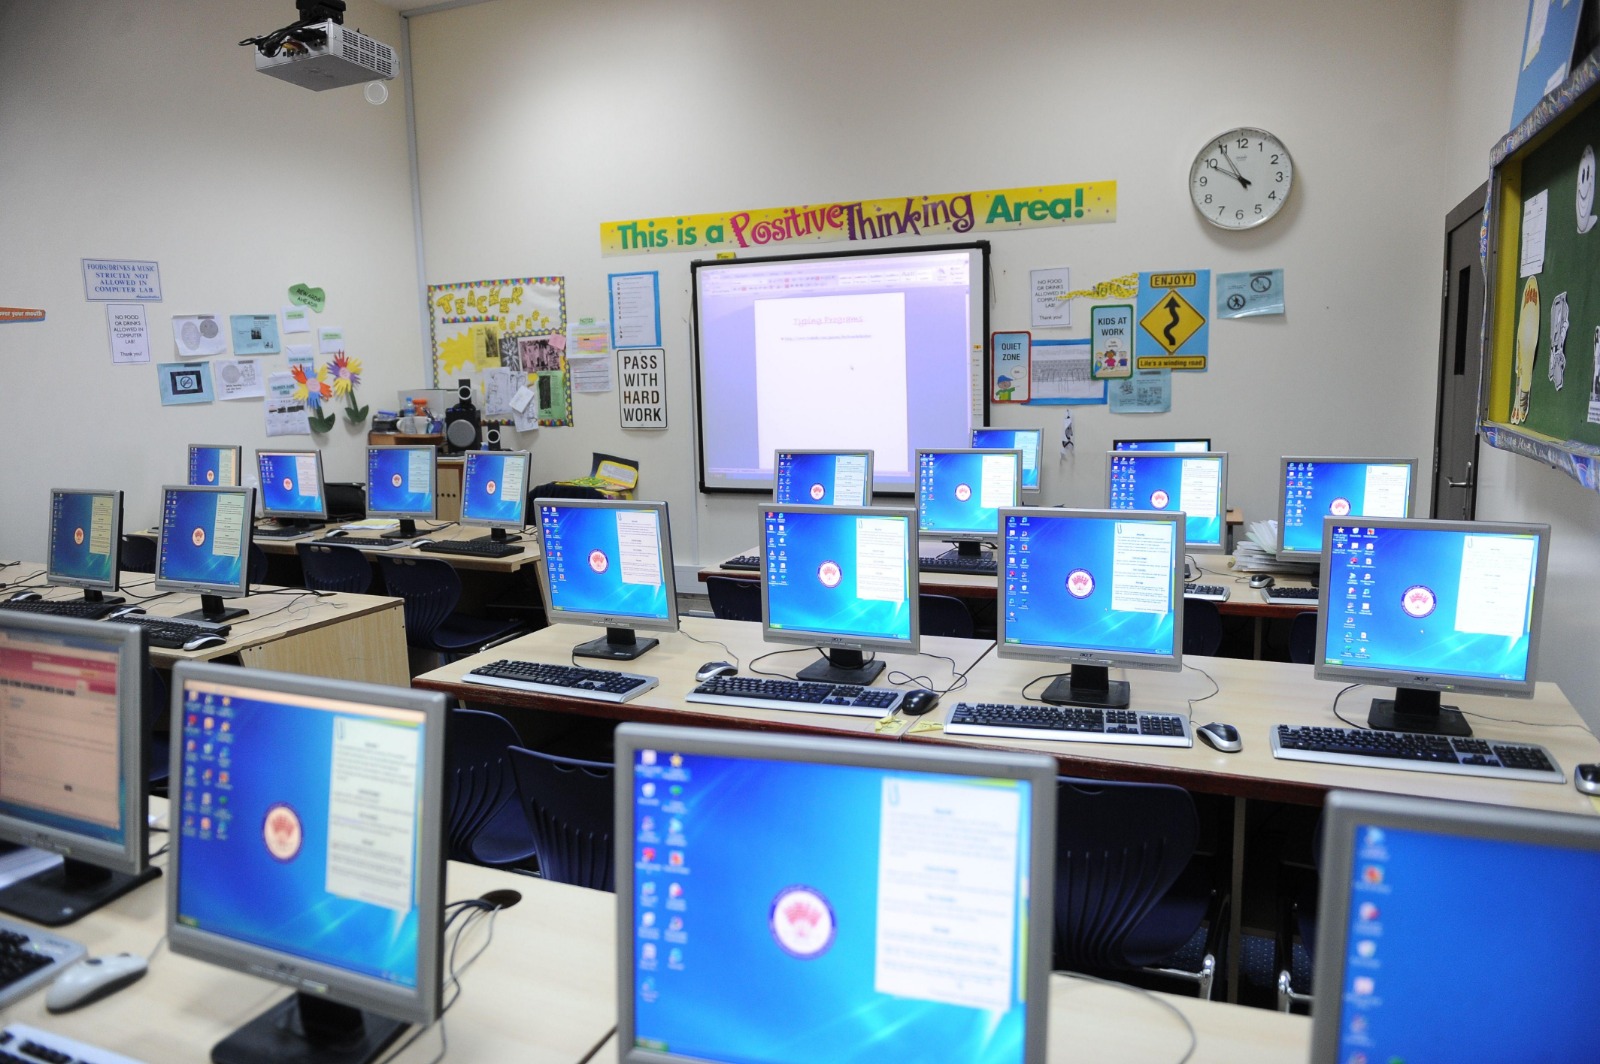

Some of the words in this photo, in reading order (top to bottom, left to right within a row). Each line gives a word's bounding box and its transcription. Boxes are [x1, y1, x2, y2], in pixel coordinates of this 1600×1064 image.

[1236, 138, 1249, 149] 12
[1258, 142, 1263, 152] 1
[1204, 158, 1218, 169] 10
[1270, 154, 1279, 164] 2
[1200, 176, 1208, 186] 9
[1275, 172, 1283, 182] 3
[1204, 194, 1212, 204] 8
[1268, 190, 1276, 200] 4
[1218, 206, 1225, 215] 7
[1255, 204, 1262, 214] 5
[617, 221, 668, 250] This
[677, 218, 697, 245] is
[706, 225, 724, 244] a
[729, 204, 844, 248] Positive
[841, 193, 975, 241] Thinking
[986, 188, 1084, 223] Area!
[1236, 210, 1244, 219] 6
[1155, 275, 1192, 286] ENJOY!
[436, 286, 523, 315] TEACHER
[1101, 328, 1124, 336] WORK
[624, 355, 657, 369] PASS
[624, 373, 657, 386] WITH
[624, 391, 659, 404] HARD
[623, 408, 662, 421] WORK
